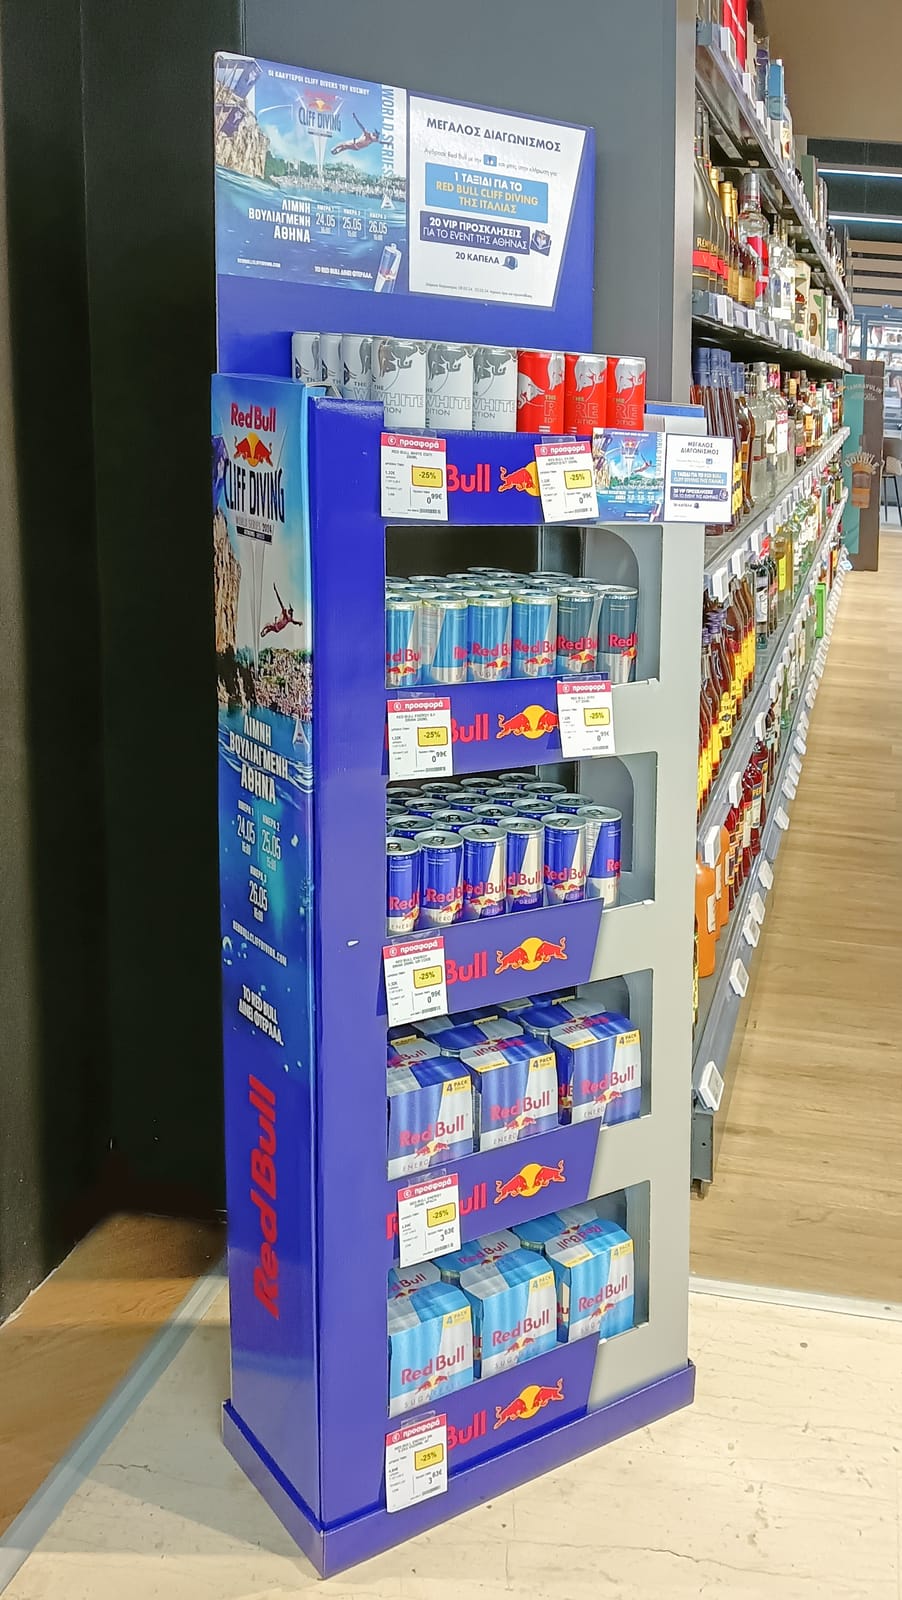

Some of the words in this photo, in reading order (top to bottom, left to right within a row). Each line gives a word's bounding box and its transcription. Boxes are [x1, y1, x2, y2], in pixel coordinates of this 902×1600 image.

[382, 87, 394, 131] WORLD
[298, 106, 316, 127] CLIFF
[317, 112, 342, 132] DIVING
[426, 117, 481, 137] ΜΕΓΑΛΟΣ
[484, 128, 561, 152] ΔΙΑΓΩΝΙΣΜΟΣ
[454, 172, 458, 182] 1
[462, 173, 492, 187] ΤΑΞΙΔΙ
[494, 177, 508, 190] ΓΙΑ
[510, 180, 522, 192] ΤΟ
[436, 180, 454, 192] RED
[456, 183, 478, 196] BULL
[480, 187, 504, 200] CLIFF
[504, 190, 539, 206] DIVING
[282, 199, 311, 214] ΛΙΜΝΗ
[459, 196, 478, 208] ΤΗΣ
[480, 198, 516, 214] ΙΤΑΛΙΑΣ
[248, 208, 311, 227] ΒΟΥΛΙΑΓΜΕΝΗ
[316, 212, 336, 228] 24.05
[342, 216, 362, 232] 25.05
[274, 225, 311, 244] ΑΘΗΝΑ
[368, 220, 388, 235] 26.05
[429, 216, 442, 228] 20
[442, 218, 458, 230] VIP
[460, 220, 522, 239] ΠΡΟΣΚΛΗΣΕΙΣ
[422, 226, 436, 237] ΓΙΑ
[437, 228, 448, 239] ΤΟ
[450, 230, 474, 242] EVENT
[475, 234, 490, 246] ΤΗΣ
[492, 236, 527, 250] ΑΘΗΝΑΣ
[456, 250, 466, 260] 20
[467, 253, 500, 265] ΚΑΠΕΛΑ
[230, 402, 253, 428] Red
[254, 405, 276, 433] Bull
[384, 406, 402, 414] TION
[400, 438, 440, 450] προσφορά
[550, 444, 586, 454] προσφορά
[418, 472, 436, 480] -25%
[569, 473, 585, 481] -25%
[224, 458, 246, 513] CLIFF
[249, 468, 284, 524] DIVING
[472, 642, 498, 658] Red
[512, 638, 540, 656] Red
[557, 634, 584, 651] Red
[572, 684, 606, 692] προσφορά
[404, 700, 444, 710] προσφορά
[590, 712, 604, 720] -25%
[244, 714, 272, 747] ΛΙΜΝΗ
[230, 730, 288, 780] ΒΟΥΛΙΑΓΜΕΝΗ
[241, 763, 276, 806] ΑΘΗΝΑ
[237, 814, 256, 844] 24.05
[262, 828, 281, 860] 25.05
[606, 859, 622, 873] Re
[518, 871, 542, 886] Bull
[249, 880, 268, 912] 26.05
[388, 892, 419, 912] Red
[426, 887, 455, 904] Red
[400, 940, 438, 953] προσφορά
[418, 972, 436, 980] -25%
[618, 1036, 625, 1046] 4
[626, 1033, 637, 1041] PACK
[532, 1059, 539, 1069] 4
[540, 1056, 553, 1065] PACK
[446, 1083, 453, 1092] 4
[454, 1078, 468, 1088] PACK
[580, 1075, 610, 1095] Red
[610, 1064, 634, 1087] Bull
[490, 1102, 521, 1122] Red
[523, 1090, 550, 1113] Bull
[248, 1073, 277, 1200] Bull
[399, 1124, 433, 1148] Red
[435, 1114, 465, 1138] Bull
[414, 1178, 452, 1195] προσφορά
[460, 1183, 487, 1217] ull
[432, 1209, 448, 1219] -25%
[250, 1188, 280, 1320] Red
[483, 1241, 509, 1256] Bull
[400, 1273, 427, 1289] Bull
[532, 1280, 538, 1289] 4
[578, 1292, 603, 1312] Red
[606, 1275, 628, 1297] Bull
[492, 1326, 520, 1348] Red
[522, 1309, 550, 1333] Bull
[401, 1358, 433, 1386] Red
[436, 1344, 465, 1372] Bull
[402, 1418, 440, 1439] προσφορά
[420, 1452, 438, 1462] -25%
